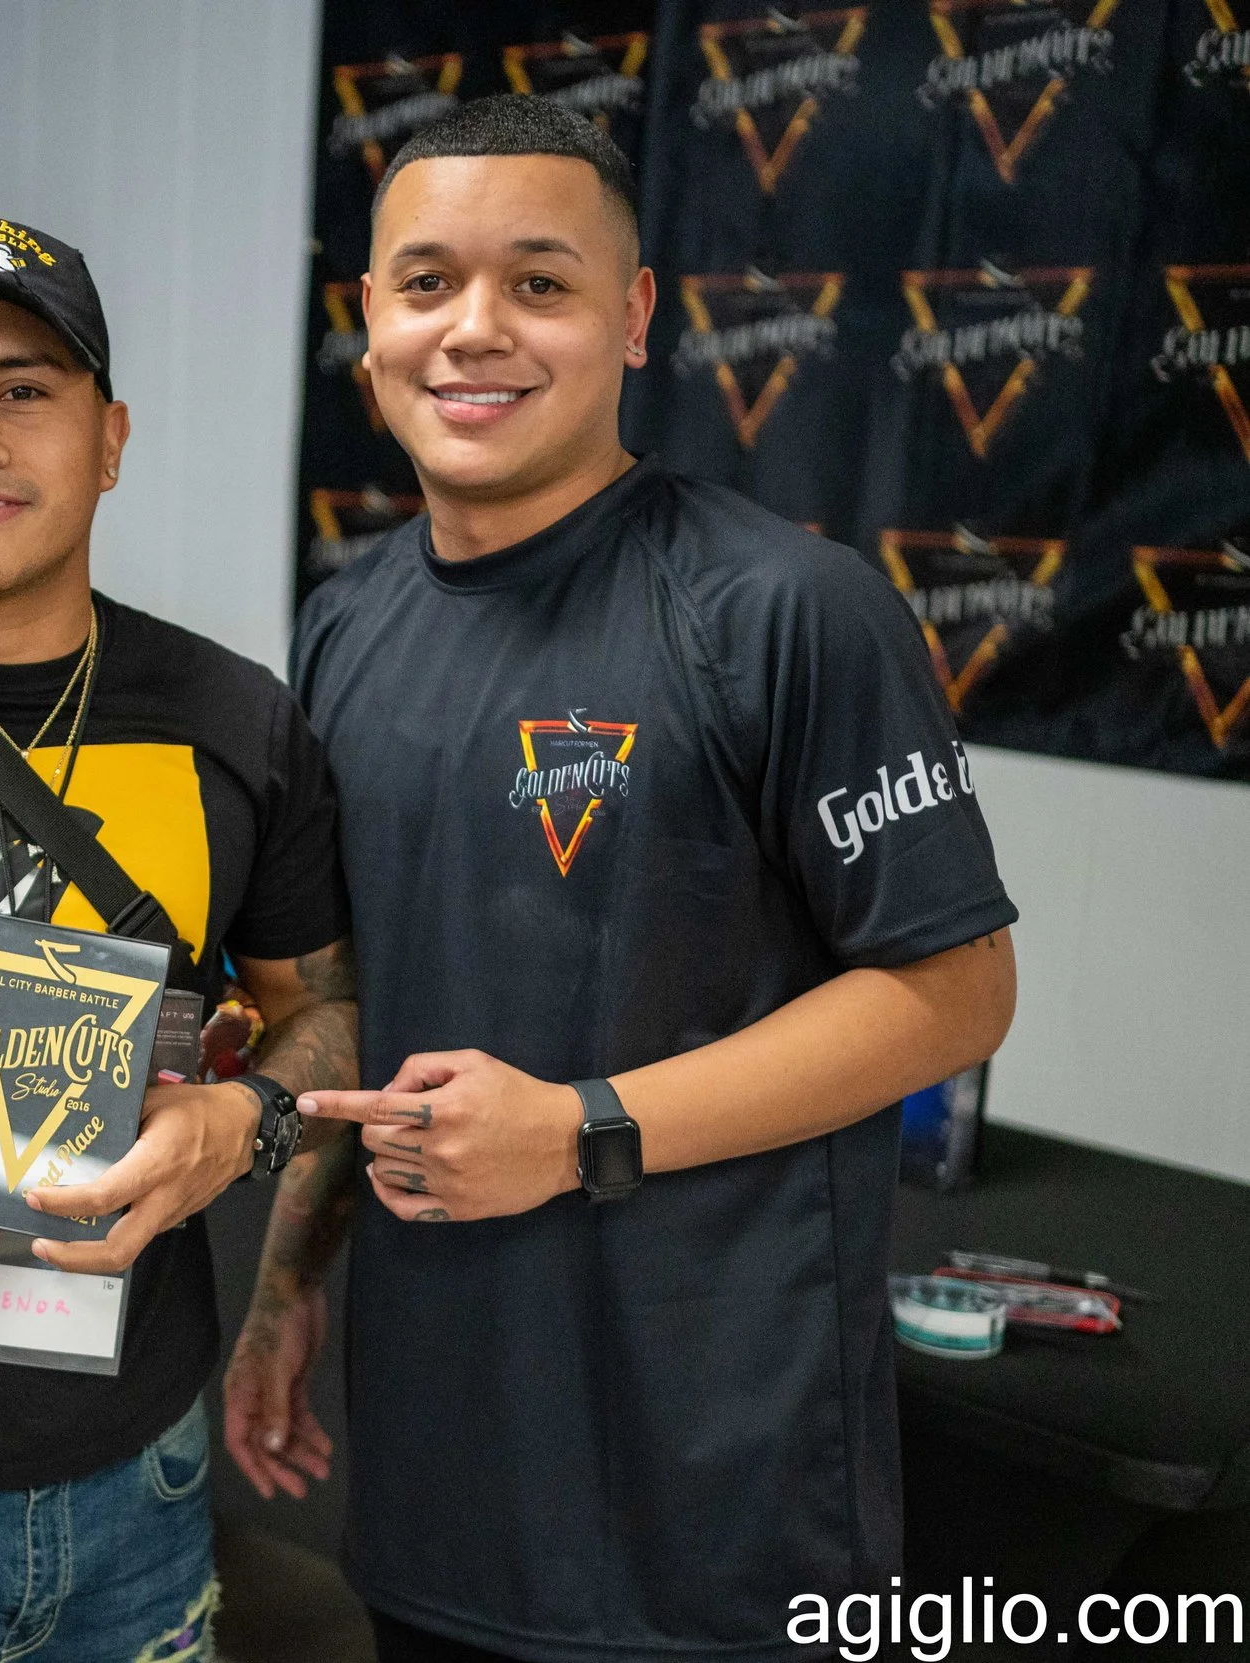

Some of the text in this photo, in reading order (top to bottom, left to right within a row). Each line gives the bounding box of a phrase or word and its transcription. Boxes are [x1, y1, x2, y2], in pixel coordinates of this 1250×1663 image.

[8, 977, 32, 993] CITY
[34, 982, 77, 1001] BARBER
[80, 990, 120, 1009] BATTLE
[11, 1072, 62, 1100] Studio
[67, 1099, 90, 1113] 2016
[55, 1115, 105, 1166] Place
